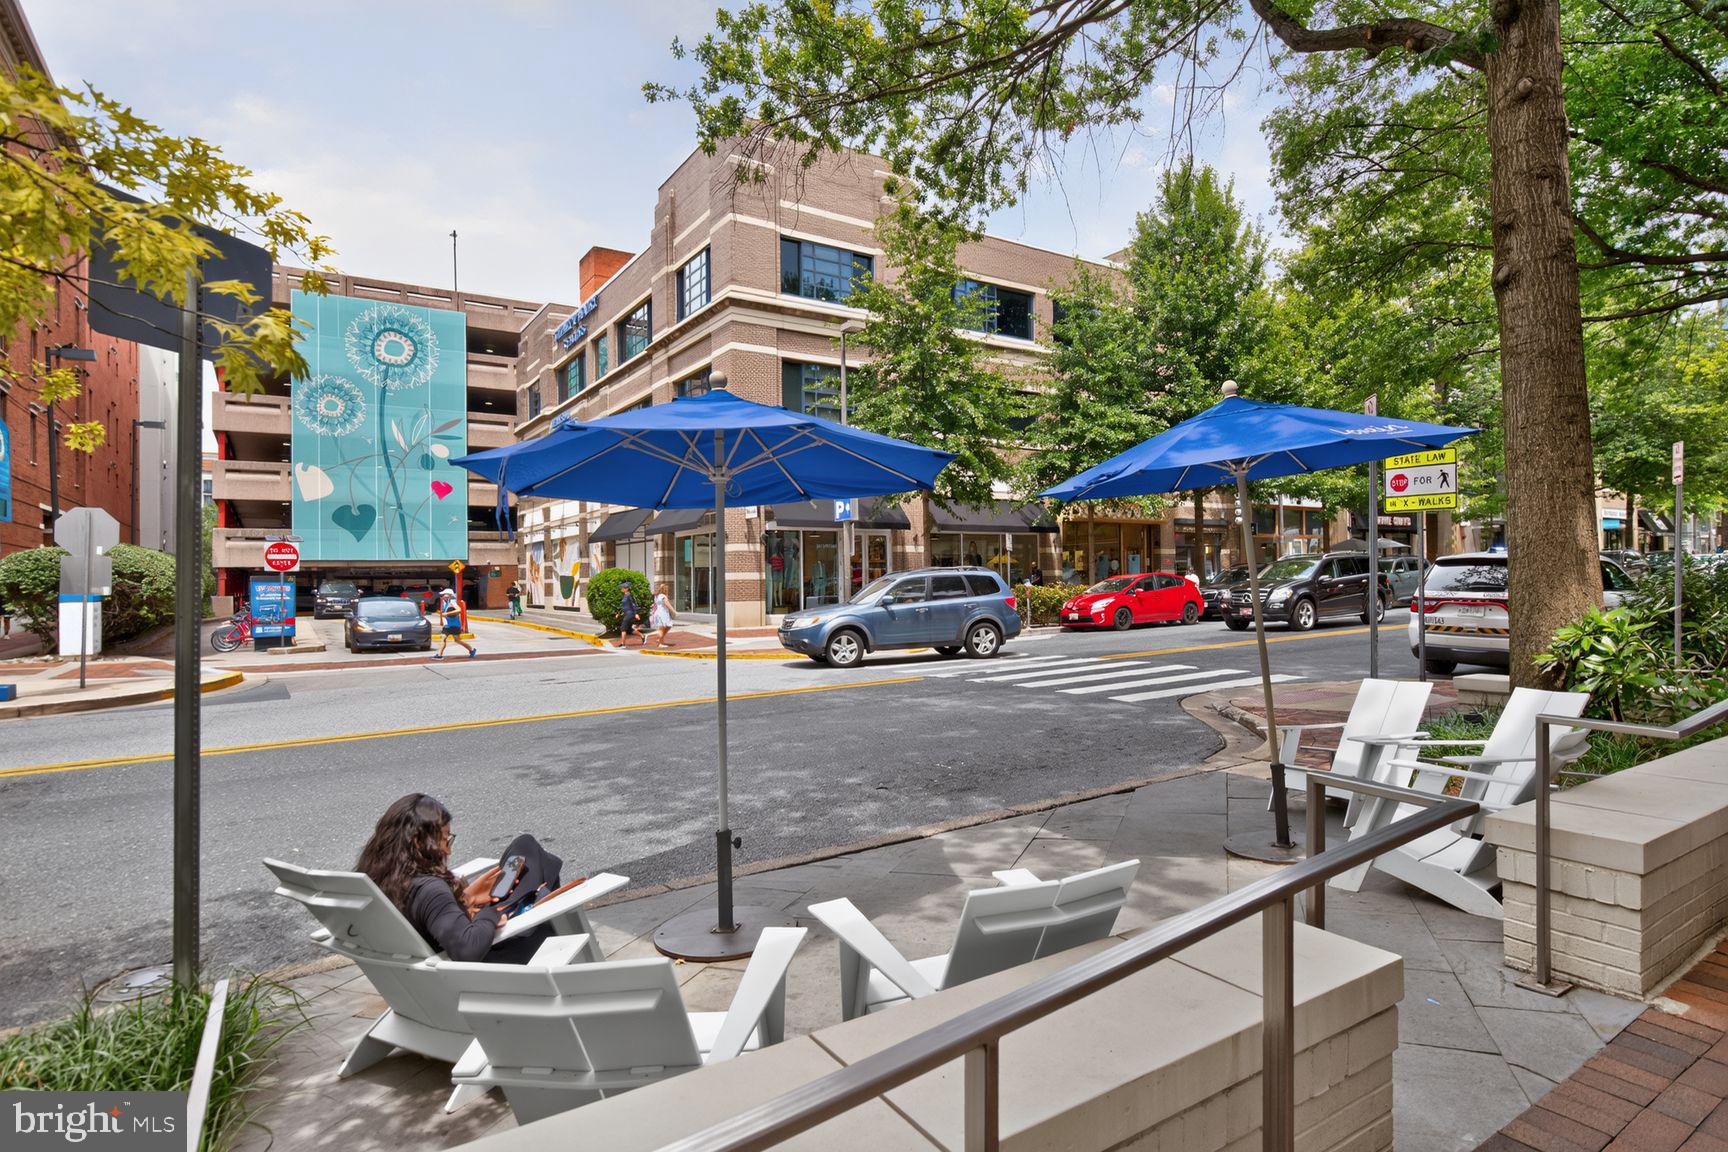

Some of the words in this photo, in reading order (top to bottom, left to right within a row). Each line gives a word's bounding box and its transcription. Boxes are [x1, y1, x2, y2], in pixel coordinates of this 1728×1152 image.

[1393, 455, 1421, 466] STATE
[1426, 452, 1447, 462] LAW
[1391, 478, 1408, 487] STOP
[1413, 476, 1432, 486] FOR
[836, 501, 845, 520] P
